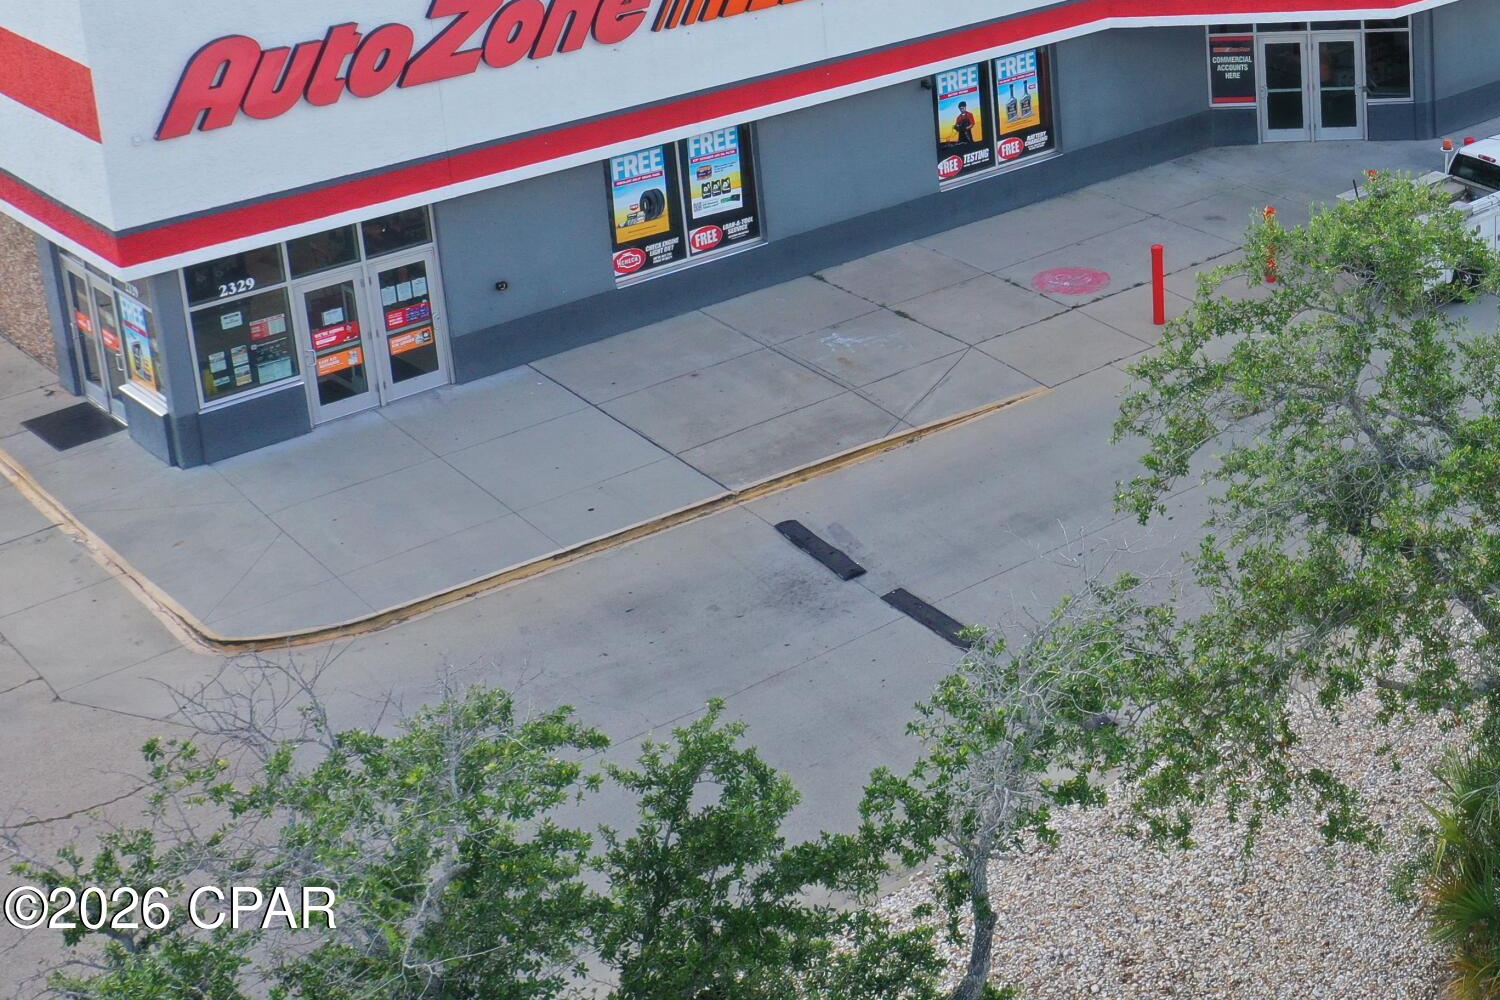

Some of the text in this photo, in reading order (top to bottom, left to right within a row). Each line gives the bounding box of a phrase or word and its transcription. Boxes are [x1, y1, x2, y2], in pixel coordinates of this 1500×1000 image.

[996, 52, 1035, 79] FREE
[1212, 55, 1252, 64] COMMERCIAL
[1216, 63, 1249, 72] ACCOUNTS
[938, 67, 978, 94] FREE
[689, 127, 737, 159] FREE
[1001, 140, 1020, 157] FREE
[612, 148, 664, 181] FREE
[963, 148, 990, 164] TESTING
[695, 229, 718, 248] FREE
[219, 278, 255, 297] 2329
